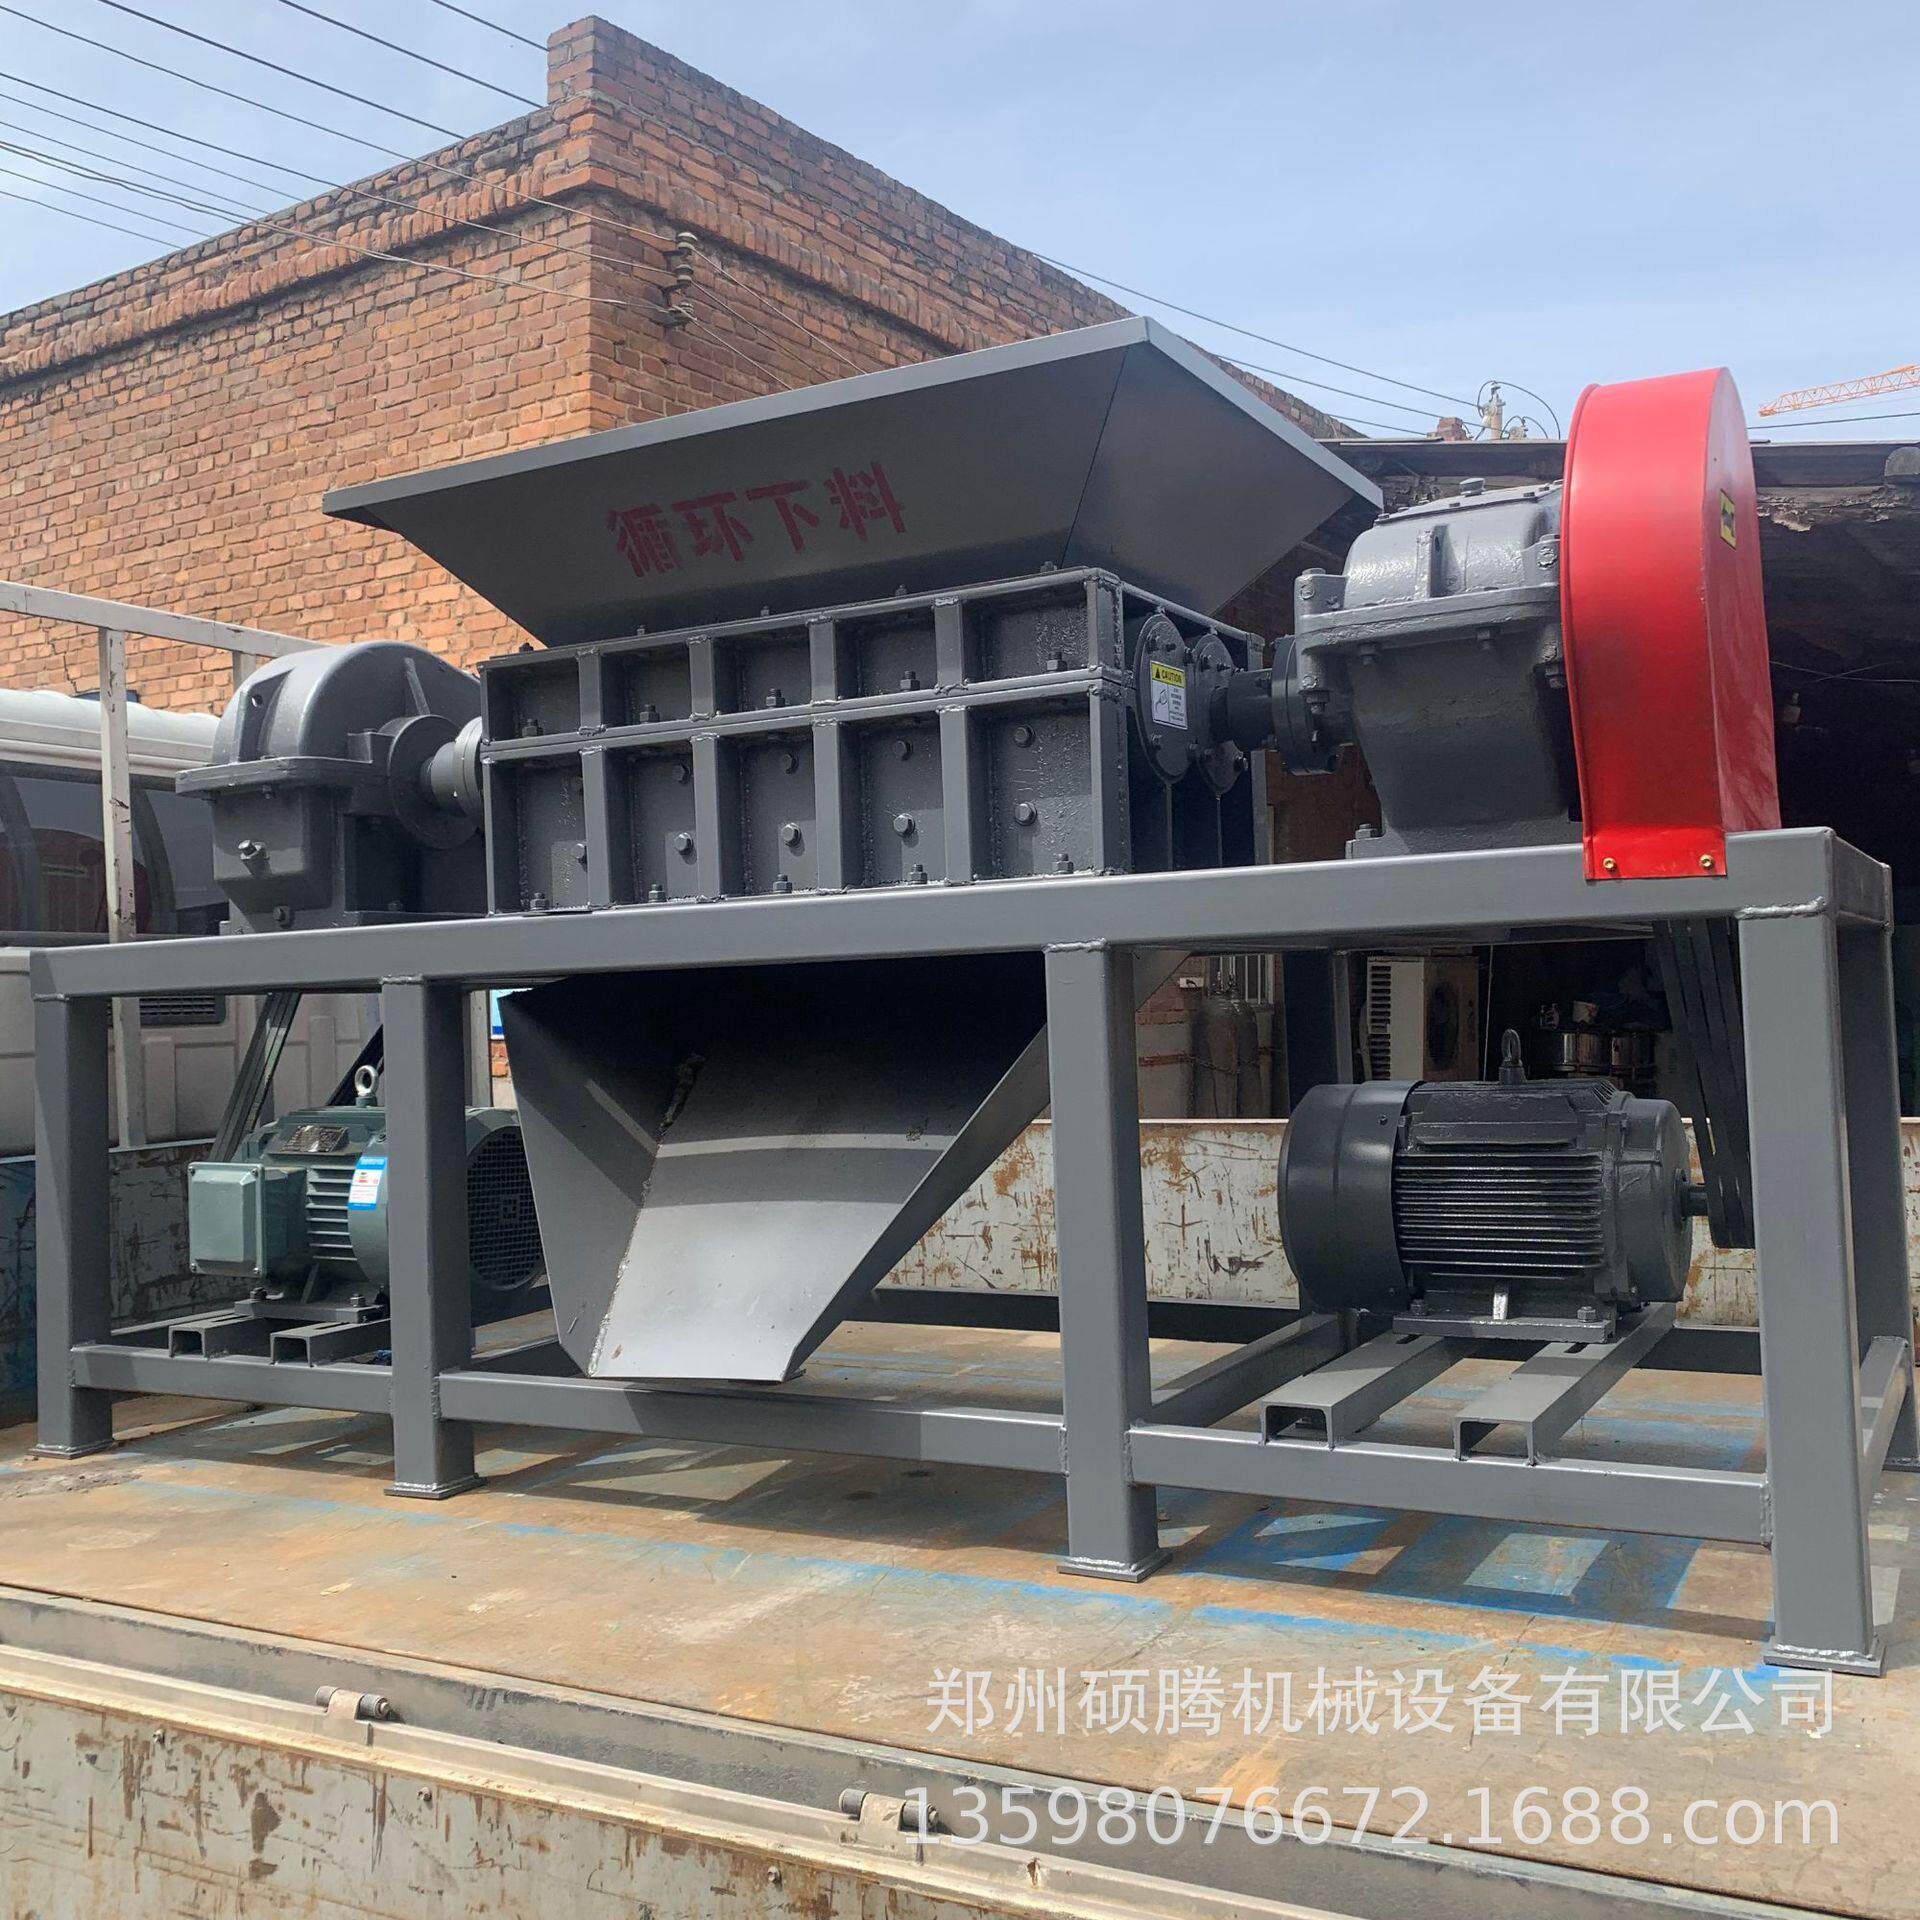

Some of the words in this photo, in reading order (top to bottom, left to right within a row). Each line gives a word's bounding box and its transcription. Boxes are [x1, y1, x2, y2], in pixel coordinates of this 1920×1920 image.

[606, 461, 906, 578] 循环下料
[1161, 669, 1182, 684] CAUTION
